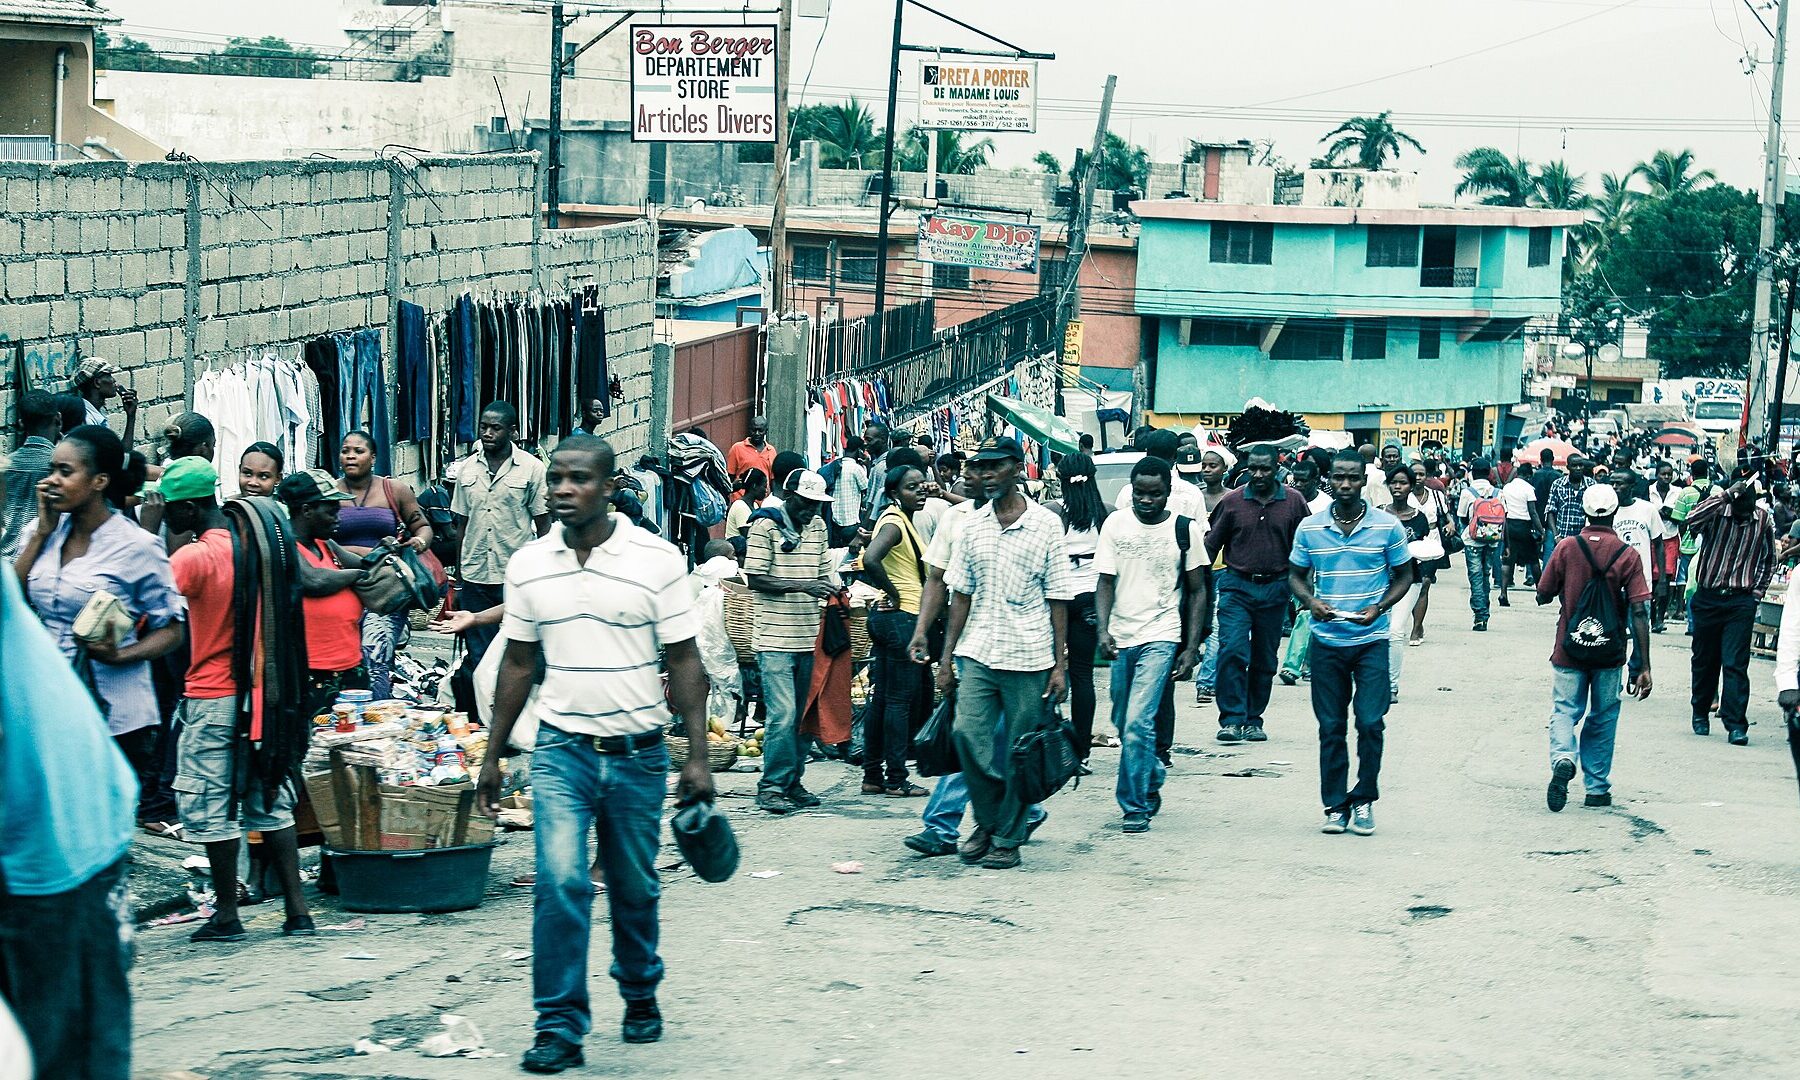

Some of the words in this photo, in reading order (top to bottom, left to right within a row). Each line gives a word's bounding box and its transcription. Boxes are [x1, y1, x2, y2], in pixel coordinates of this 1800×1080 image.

[635, 30, 684, 55] Bon
[690, 30, 774, 65] Berger
[645, 57, 762, 77] DEPARTEMENT
[940, 68, 970, 86] PRET
[971, 69, 980, 86] A
[984, 69, 1030, 88] PORTER
[677, 79, 730, 99] STORE
[933, 87, 945, 99] DE
[949, 87, 991, 100] MADAME
[994, 88, 1019, 100] LOUIS
[637, 104, 708, 133] Articles
[717, 104, 773, 134] Divers
[928, 218, 980, 240] Kay
[984, 223, 1033, 245] Djo
[1394, 412, 1446, 425] SUPER
